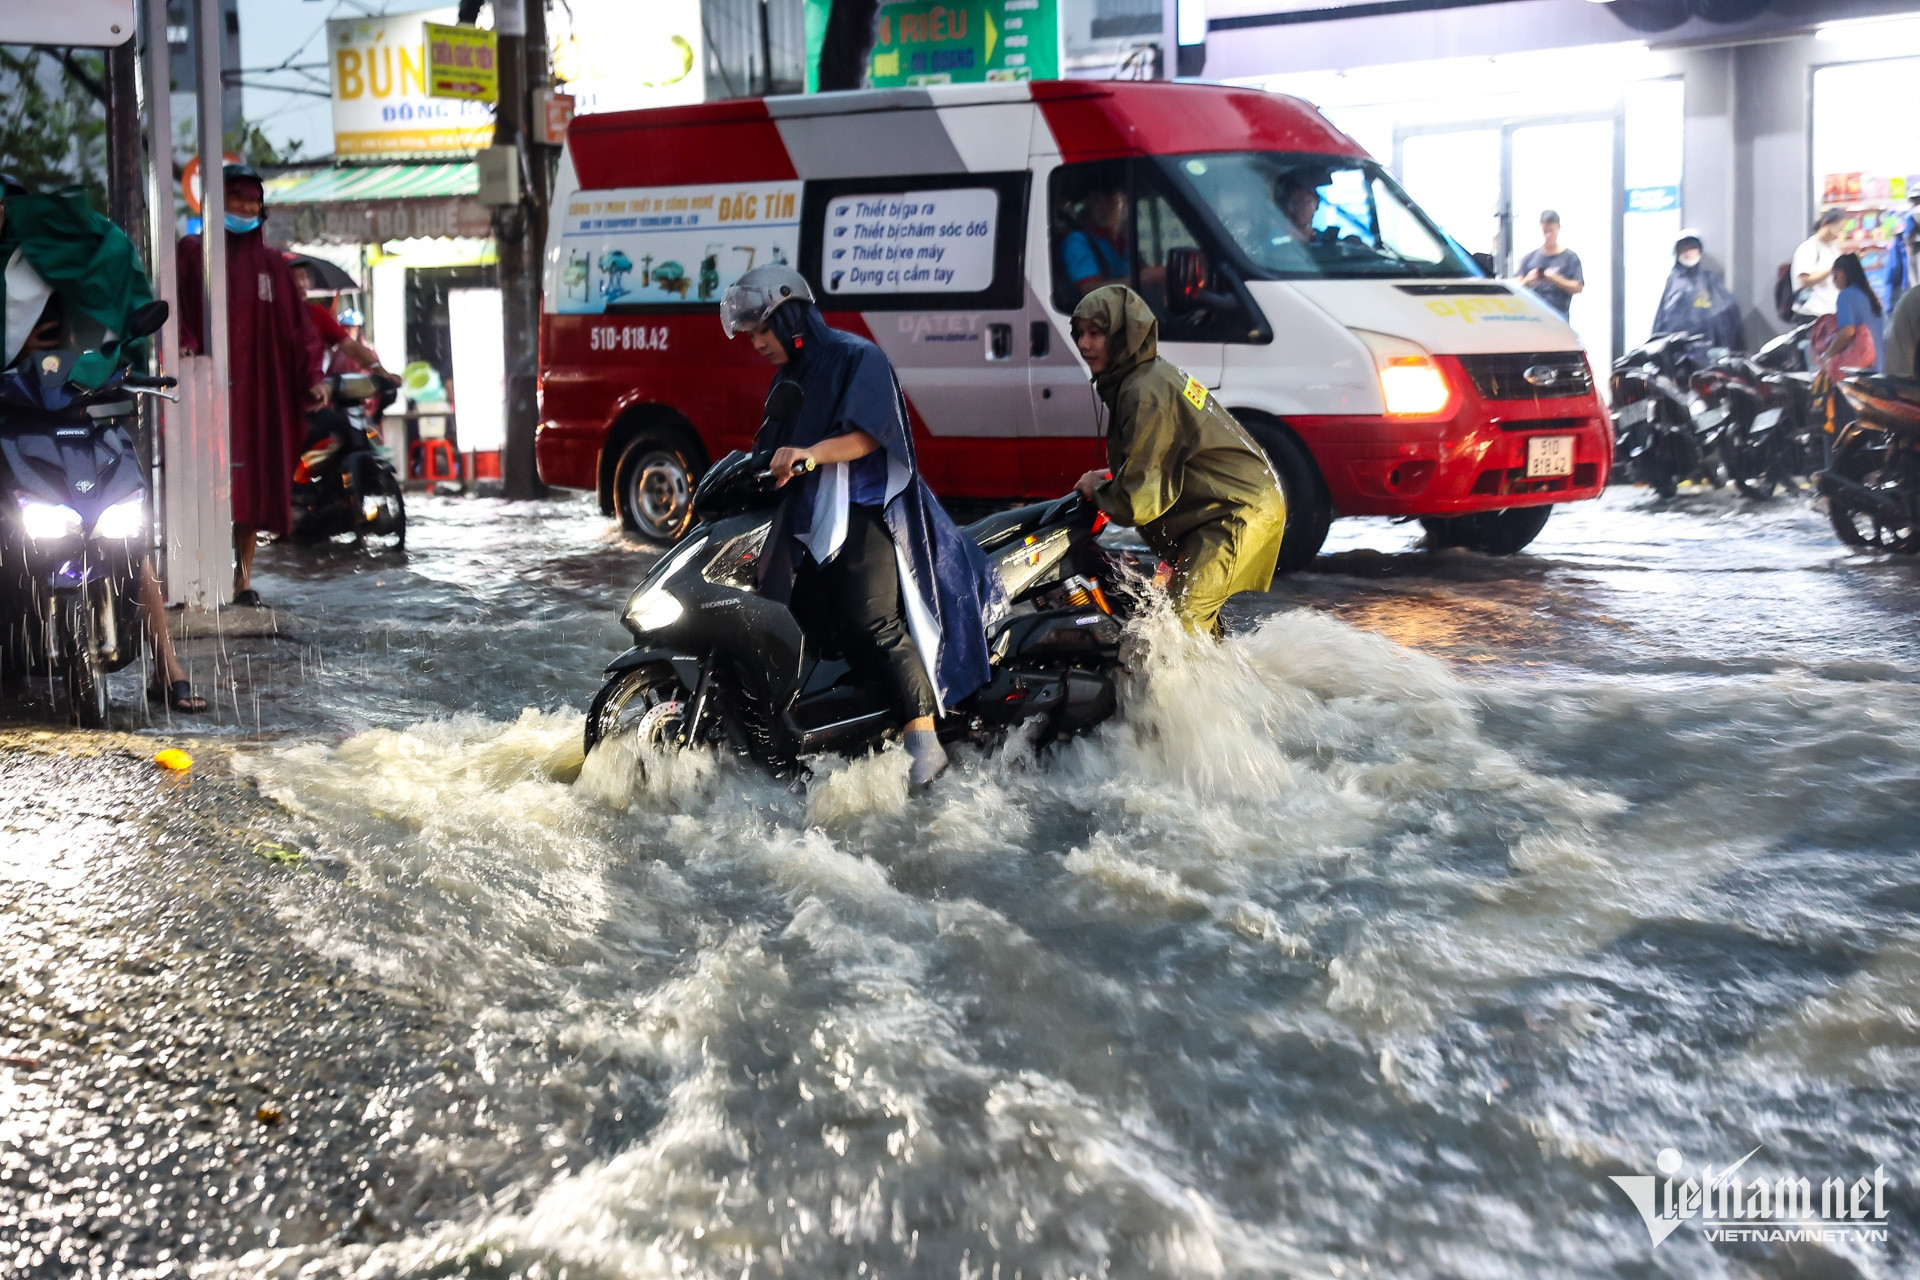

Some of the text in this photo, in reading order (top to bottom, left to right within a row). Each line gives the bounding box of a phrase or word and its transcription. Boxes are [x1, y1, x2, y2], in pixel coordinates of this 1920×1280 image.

[336, 31, 425, 102] BÚN
[764, 188, 796, 219] TÍN
[855, 199, 887, 217] Thiết
[902, 203, 919, 219] ga
[921, 203, 935, 215] ra
[853, 219, 885, 239] Thiết
[938, 221, 962, 237] sóc
[852, 241, 883, 261] Thiết
[900, 246, 914, 259] xe
[916, 244, 946, 263] máy
[850, 266, 884, 286] Dụng
[933, 267, 955, 285] tay
[589, 325, 669, 350] 51D-818.42
[700, 597, 742, 610] HONDA
